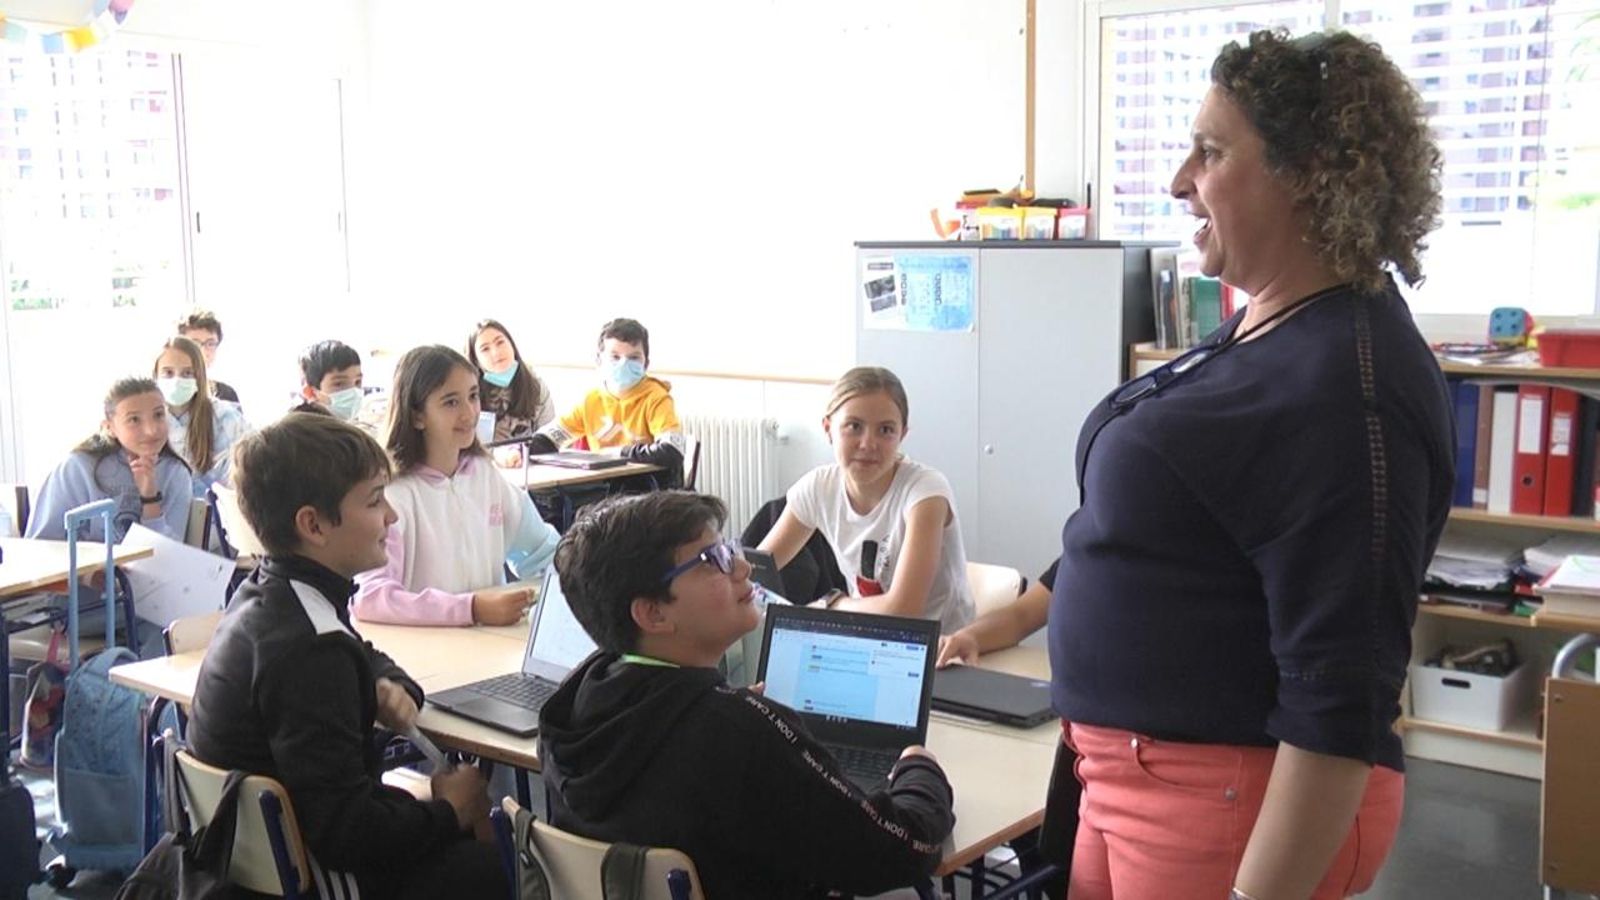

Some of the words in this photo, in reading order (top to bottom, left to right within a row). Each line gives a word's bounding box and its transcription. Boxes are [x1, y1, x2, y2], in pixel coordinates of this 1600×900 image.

[768, 713, 794, 740] DONT
[821, 771, 849, 794] DONT
[877, 816, 905, 838] DONT
